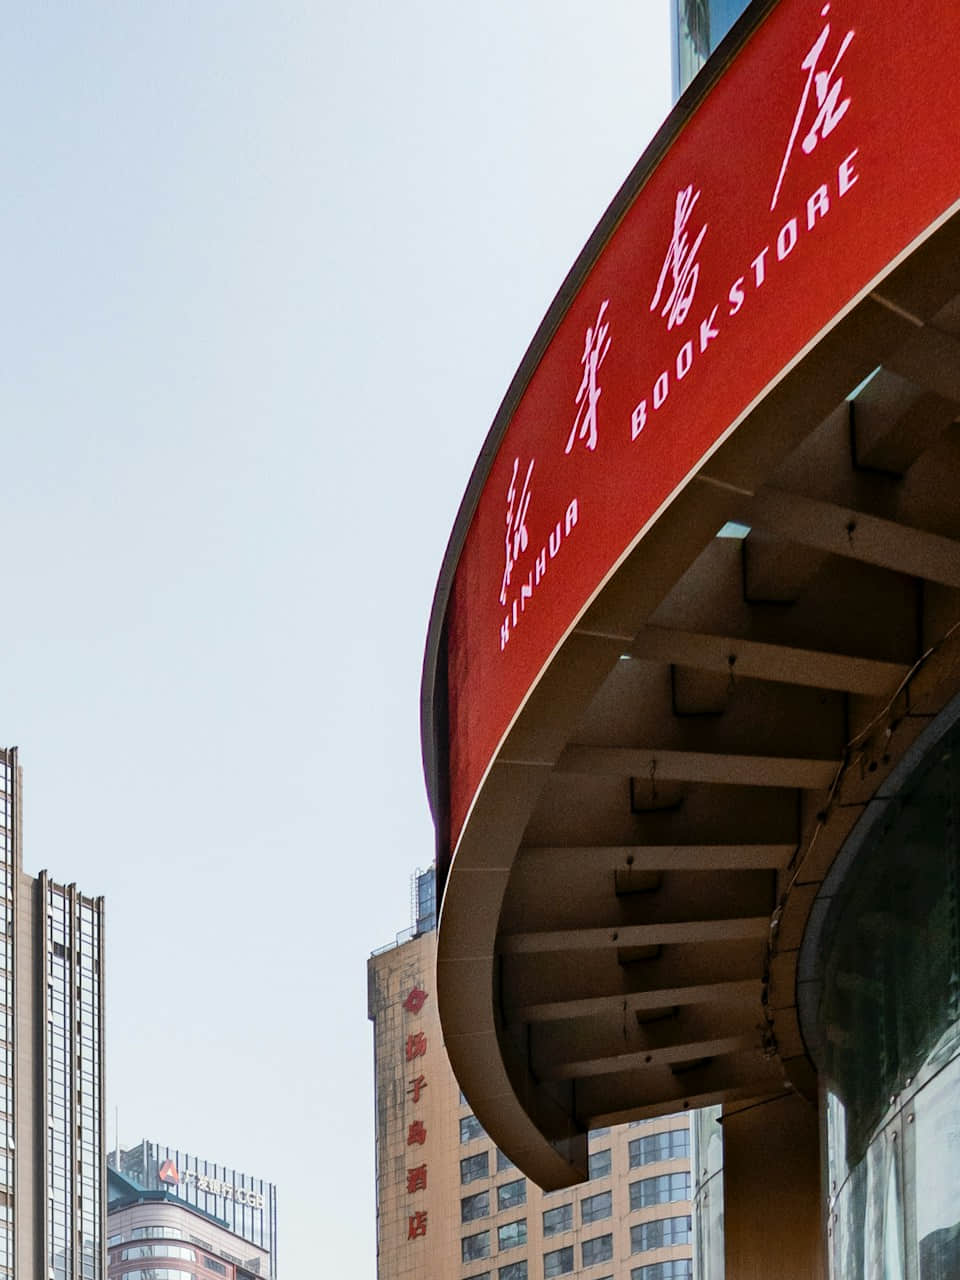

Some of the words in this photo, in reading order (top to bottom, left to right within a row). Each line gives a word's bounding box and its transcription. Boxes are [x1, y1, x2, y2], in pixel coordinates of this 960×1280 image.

[498, 497, 581, 651] XINHUA
[630, 147, 860, 442] BOOKSTORE
[405, 1031, 428, 1241] 扬子岛酒店
